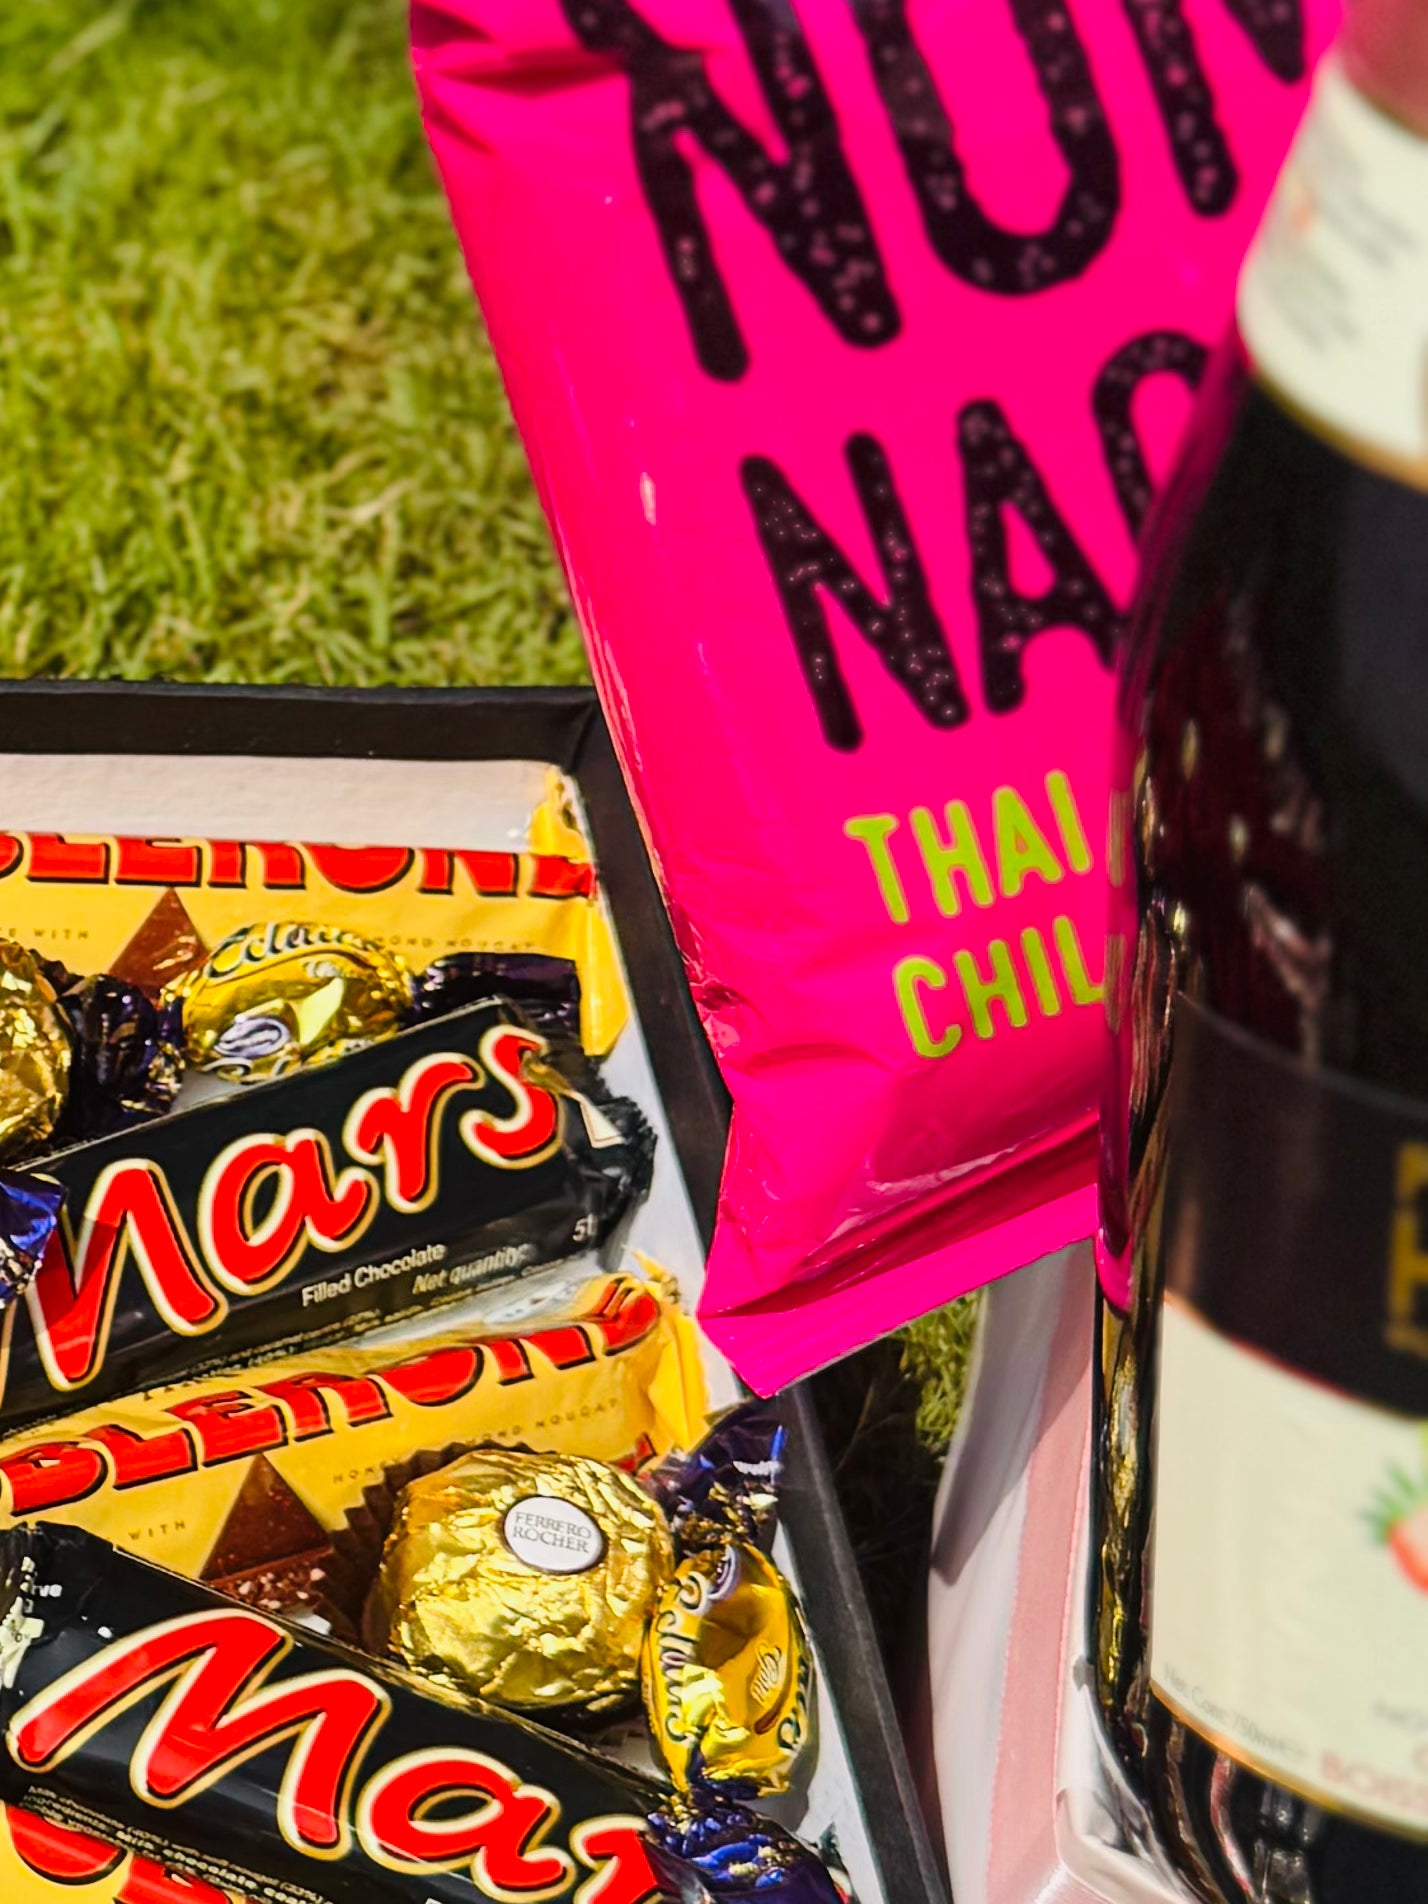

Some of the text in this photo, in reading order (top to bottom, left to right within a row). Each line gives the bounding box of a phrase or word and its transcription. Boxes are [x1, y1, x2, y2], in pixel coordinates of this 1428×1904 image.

[844, 768, 1094, 925] THAI
[891, 914, 1107, 1060] CHIL
[301, 1241, 447, 1308] Filled Chocolate
[412, 1269, 446, 1294] Net
[333, 1457, 389, 1484] HON
[128, 1519, 187, 1542] WITH
[514, 1510, 592, 1539] FERRERO
[512, 1525, 590, 1554] ROCHER
